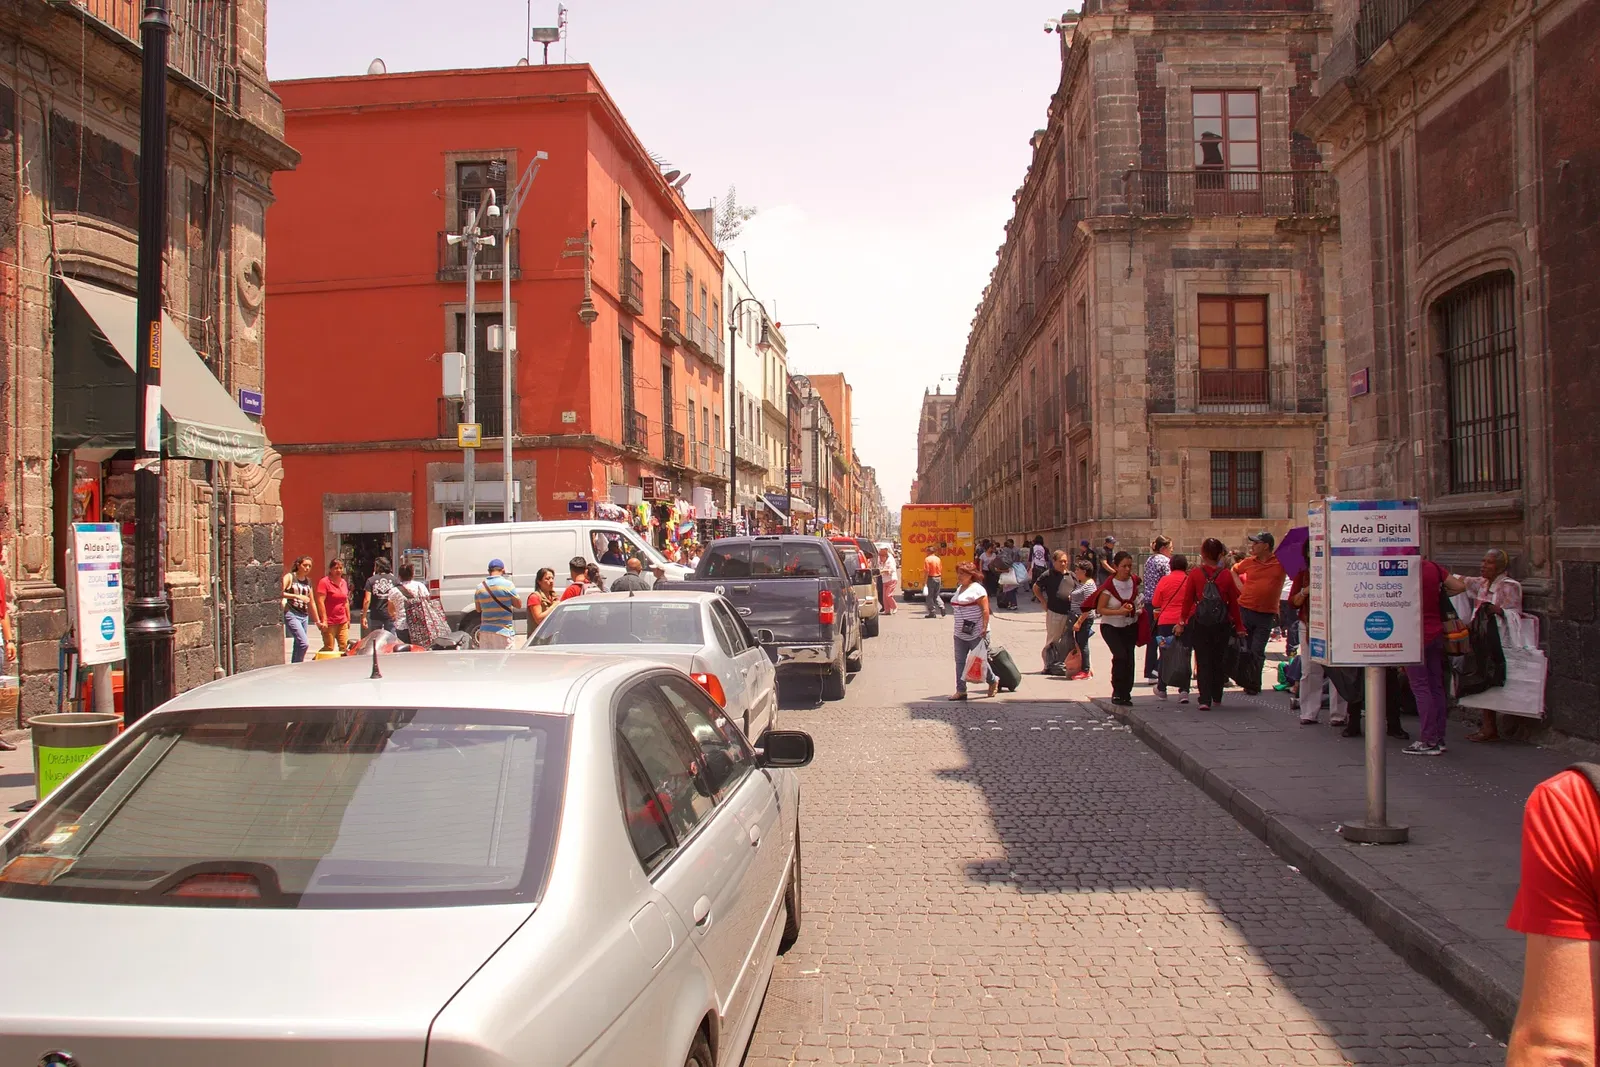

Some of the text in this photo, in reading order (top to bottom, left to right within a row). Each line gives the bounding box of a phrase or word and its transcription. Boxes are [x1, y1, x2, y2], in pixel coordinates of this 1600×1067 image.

[1340, 523, 1411, 536] Aldea Digital
[908, 533, 956, 544] COMER
[84, 543, 104, 552] Aldea
[1380, 561, 1389, 570] 10
[1397, 561, 1408, 570] 26
[1354, 581, 1403, 593] ¿No sabes
[1386, 590, 1403, 599] tuit?
